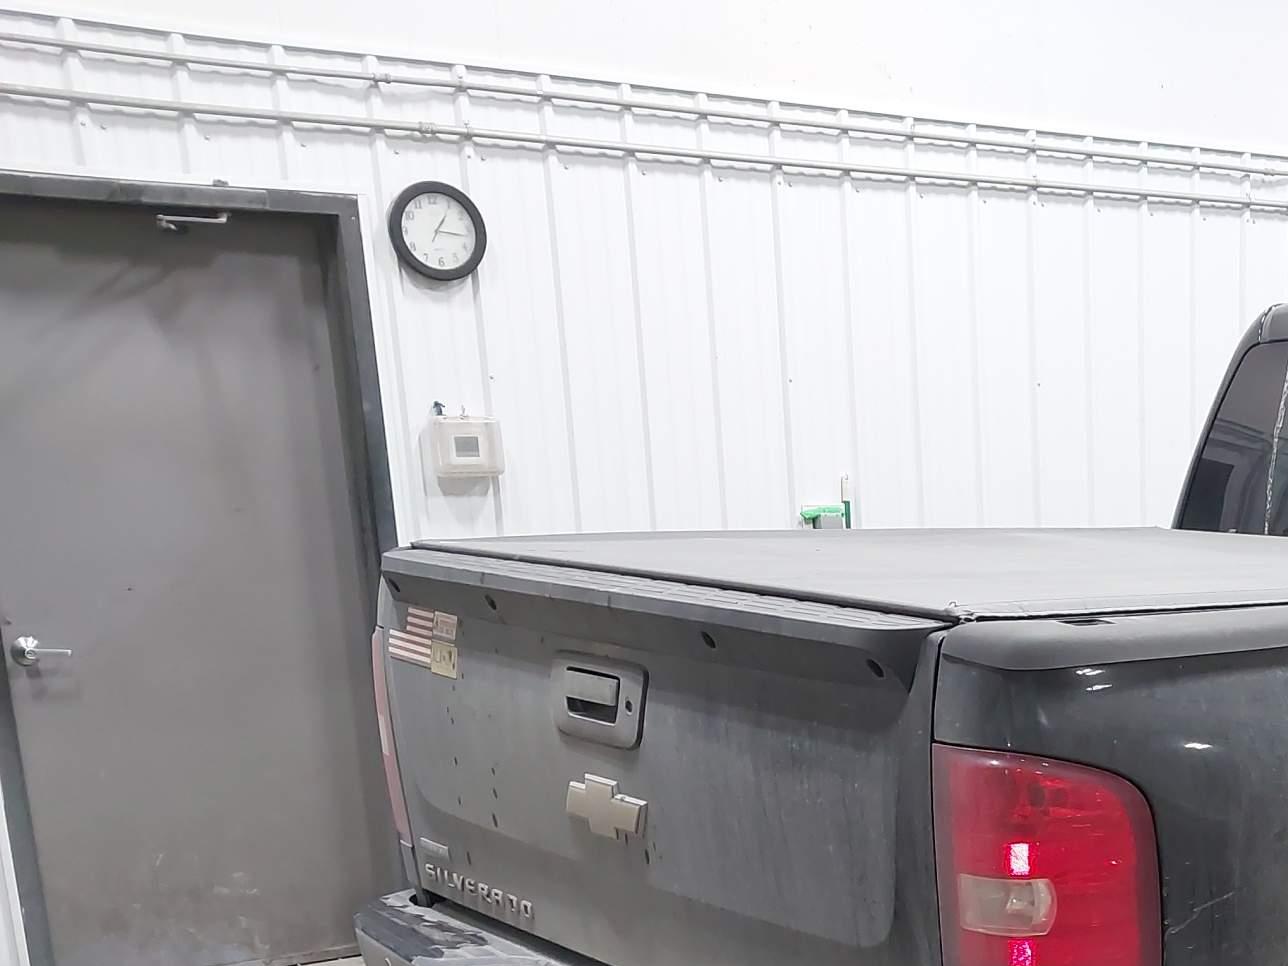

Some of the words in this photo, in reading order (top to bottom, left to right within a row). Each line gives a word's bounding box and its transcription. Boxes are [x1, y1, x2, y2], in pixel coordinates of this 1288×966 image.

[414, 199, 422, 209] 11
[427, 195, 438, 205] 12
[405, 210, 415, 221] 10
[438, 257, 445, 267] 6
